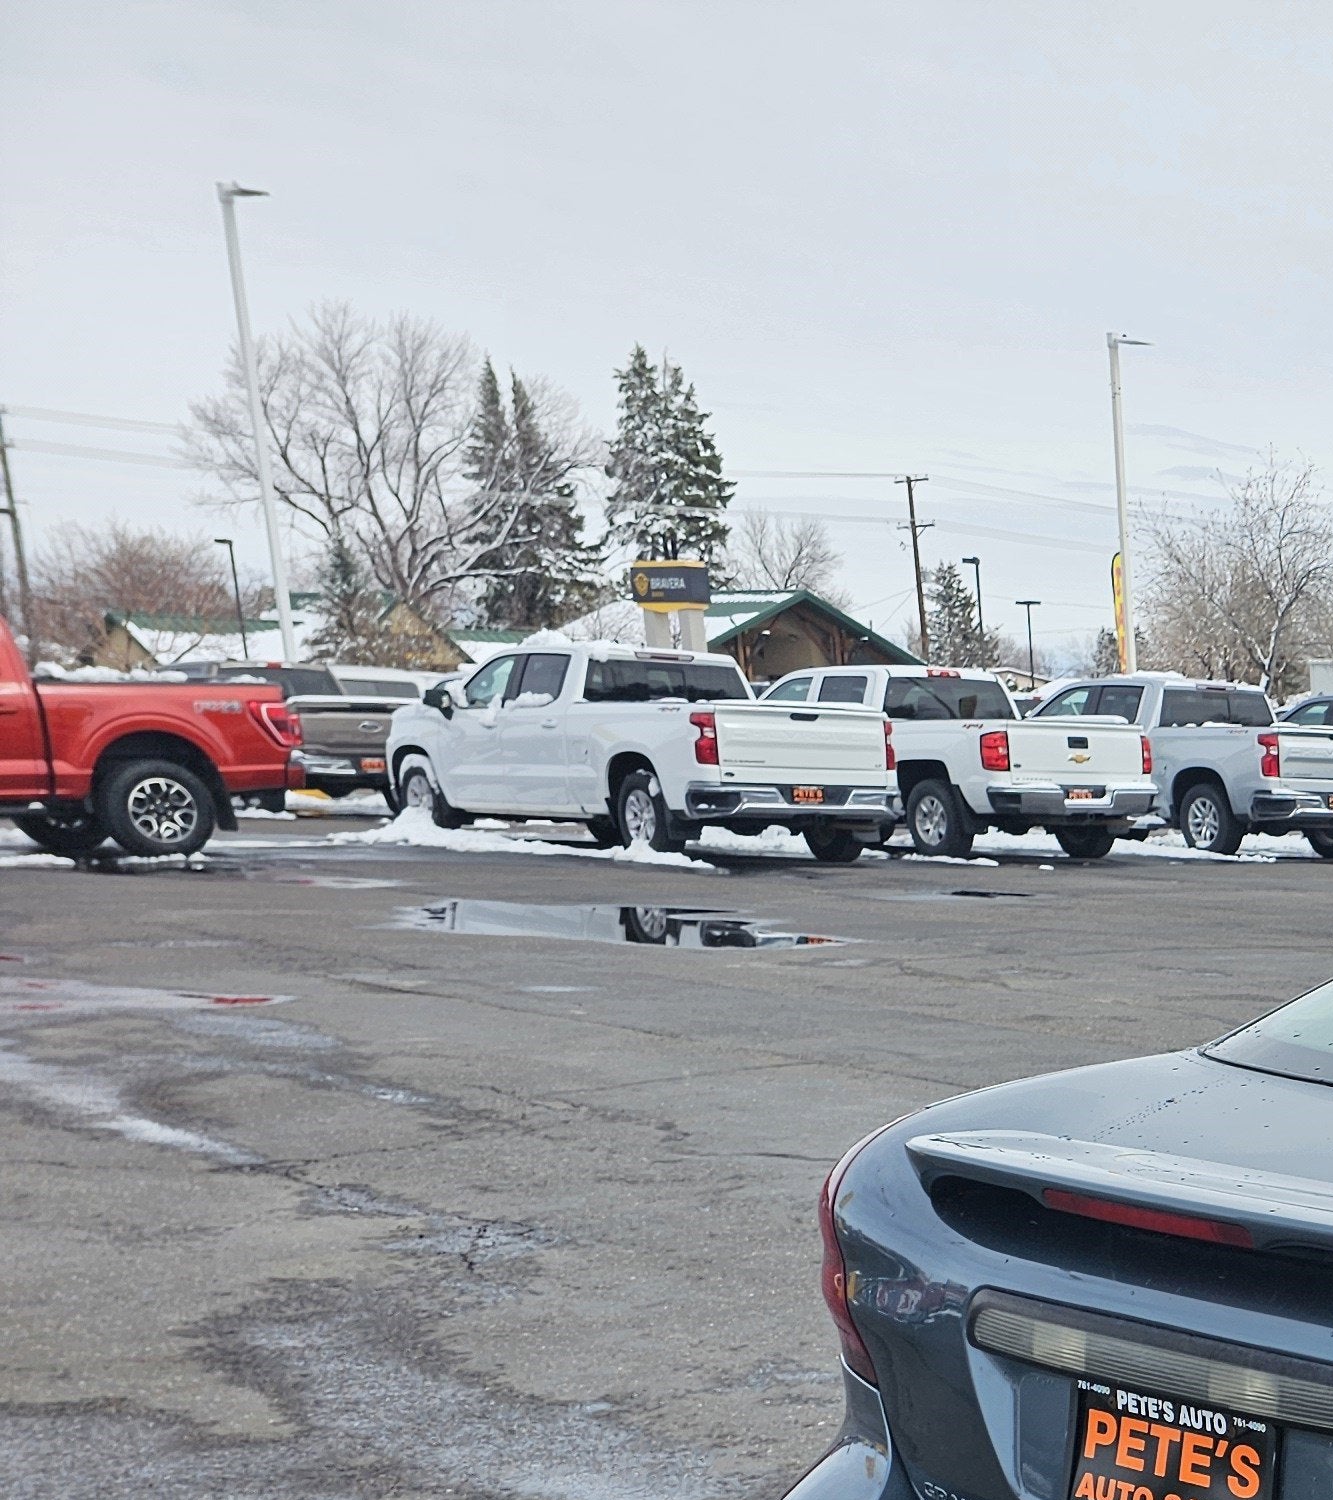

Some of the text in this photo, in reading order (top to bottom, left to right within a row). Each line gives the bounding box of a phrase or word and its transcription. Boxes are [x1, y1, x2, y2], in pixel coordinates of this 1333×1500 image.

[1116, 1389, 1227, 1434] PETE'S AUTO
[1083, 1408, 1261, 1499] PETE'S
